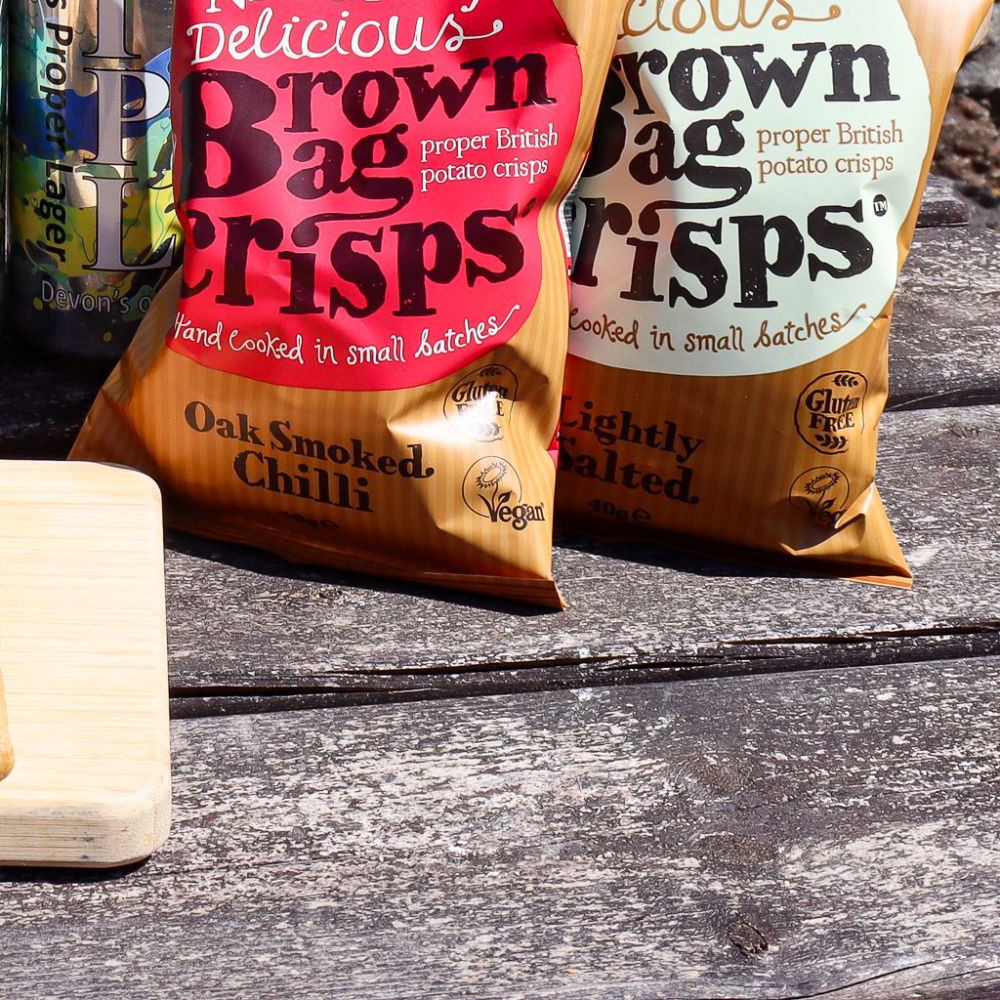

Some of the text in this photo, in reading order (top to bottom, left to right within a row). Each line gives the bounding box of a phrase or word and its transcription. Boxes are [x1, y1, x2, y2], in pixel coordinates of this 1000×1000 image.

[186, 7, 503, 66] Delicious
[40, 21, 74, 159] Proper
[181, 53, 557, 199] Brown
[420, 123, 558, 163] proper British
[756, 120, 904, 153] proper British
[420, 154, 549, 192] potato crisps
[757, 154, 895, 184] potato crisps
[35, 160, 67, 264] Lager
[569, 195, 875, 309] risps
[174, 311, 222, 351] Hand
[314, 338, 338, 365] in
[347, 335, 405, 365] small
[414, 304, 520, 359] batches
[650, 325, 676, 351] in
[684, 325, 746, 353] small
[753, 303, 868, 349] batches
[456, 400, 505, 417] FE
[561, 395, 705, 463] Lightly
[808, 411, 855, 432] FREE
[184, 400, 436, 479] Oak Smoked
[233, 450, 374, 513] Chilli
[477, 493, 546, 531] Vegan
